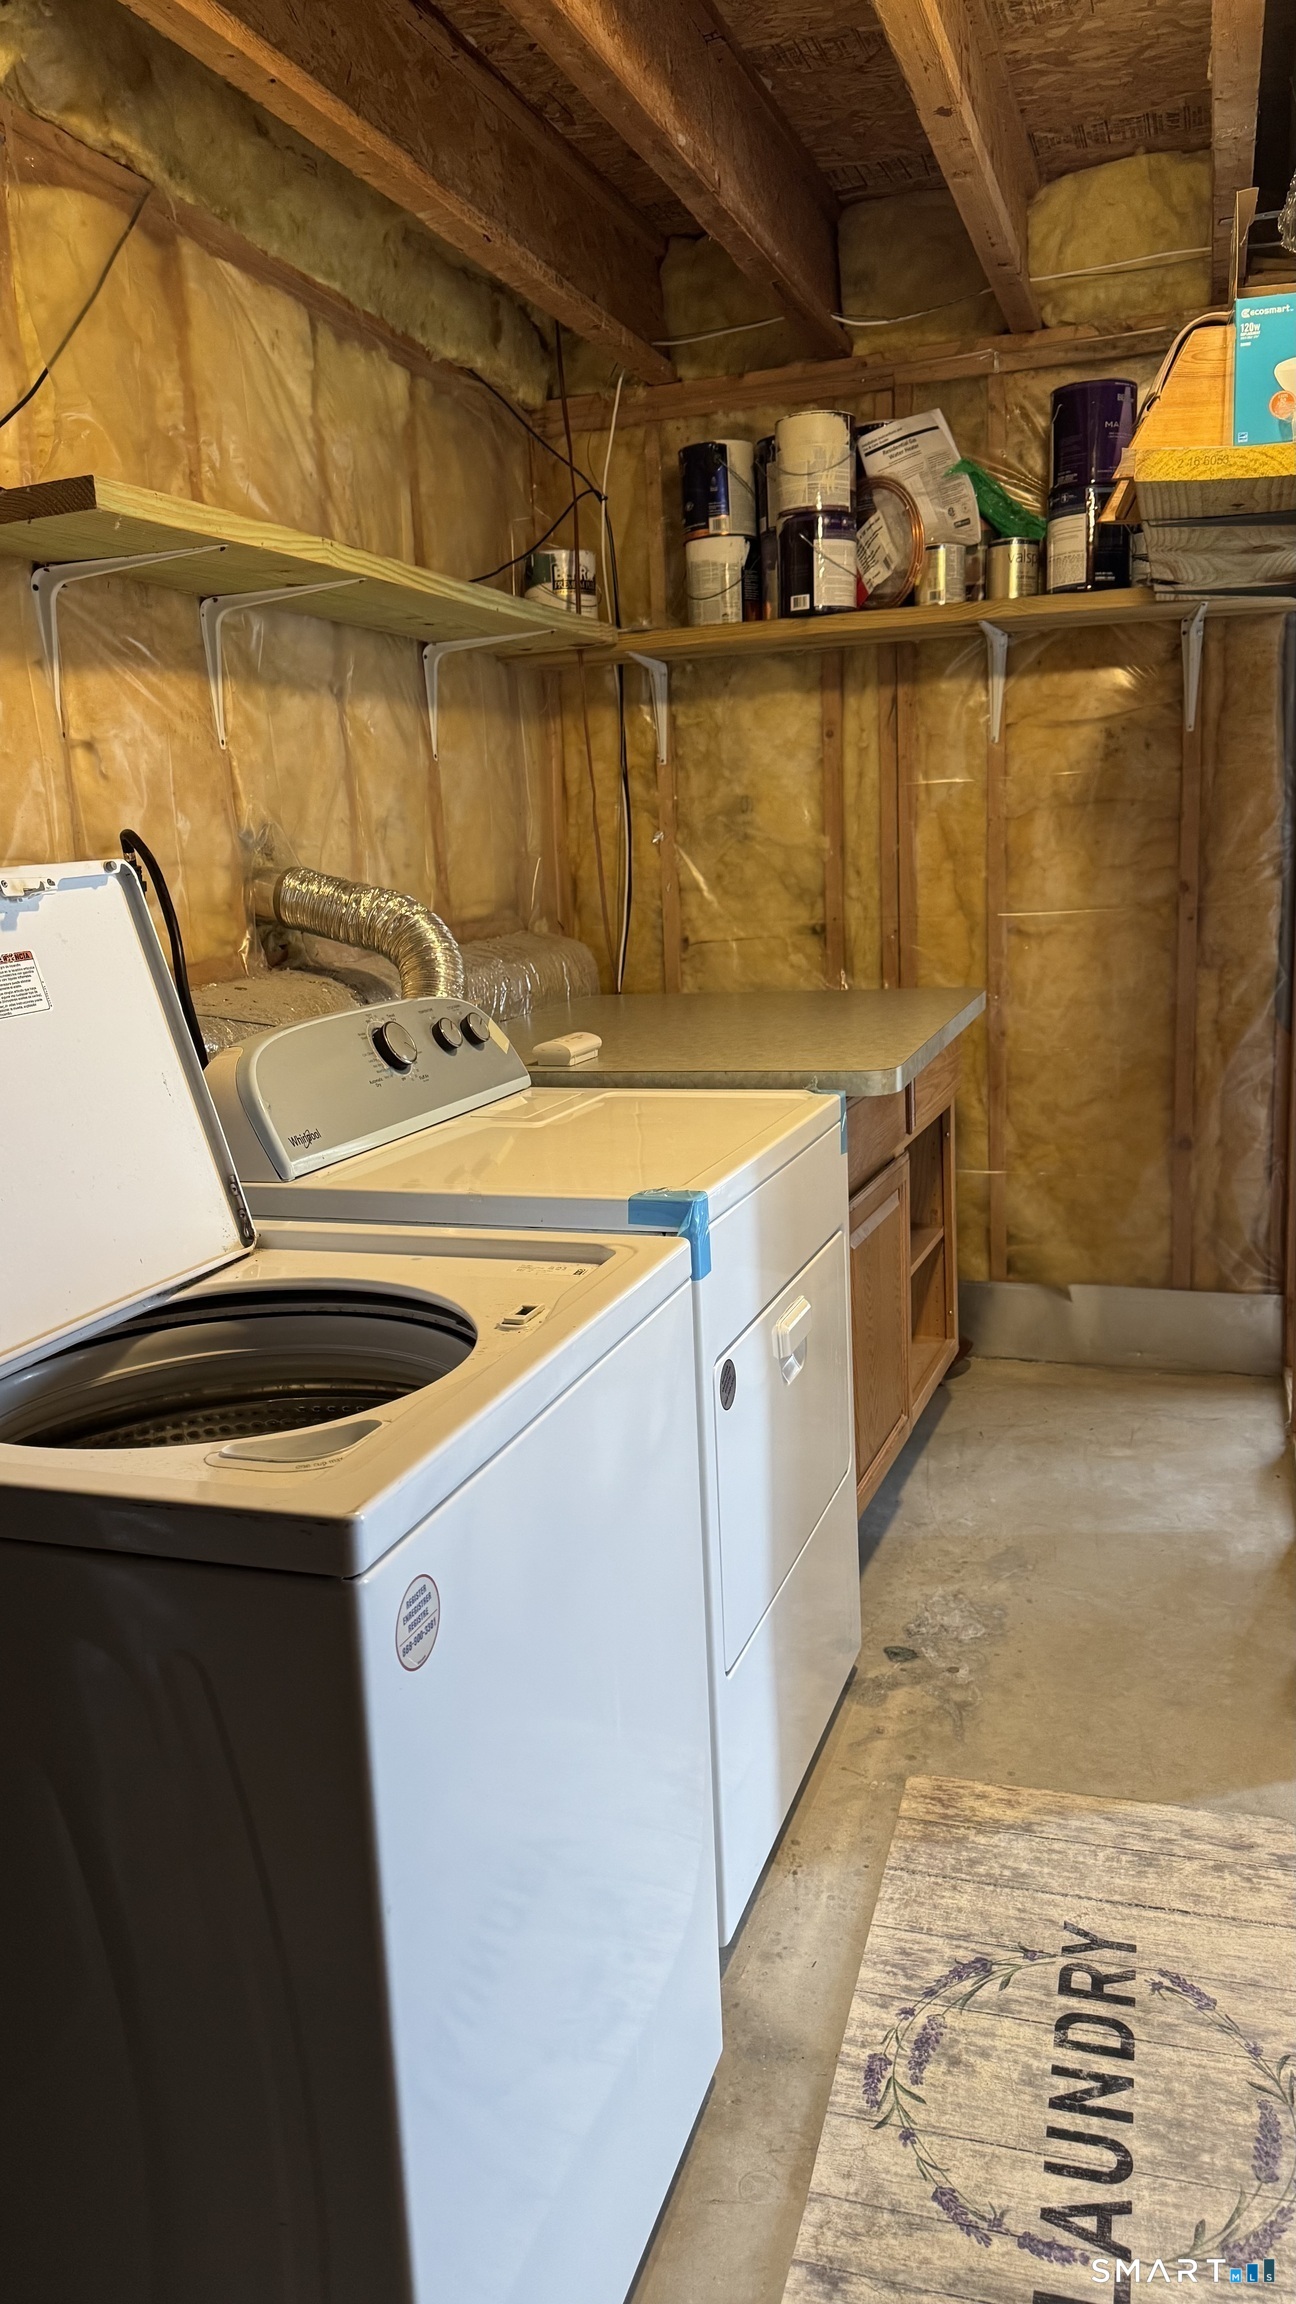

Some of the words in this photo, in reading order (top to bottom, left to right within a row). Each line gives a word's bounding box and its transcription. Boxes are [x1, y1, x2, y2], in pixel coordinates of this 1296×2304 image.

[1250, 304, 1290, 316] ecosmart
[288, 1129, 322, 1148] Whirlpool
[406, 1584, 427, 1610] REGISTER
